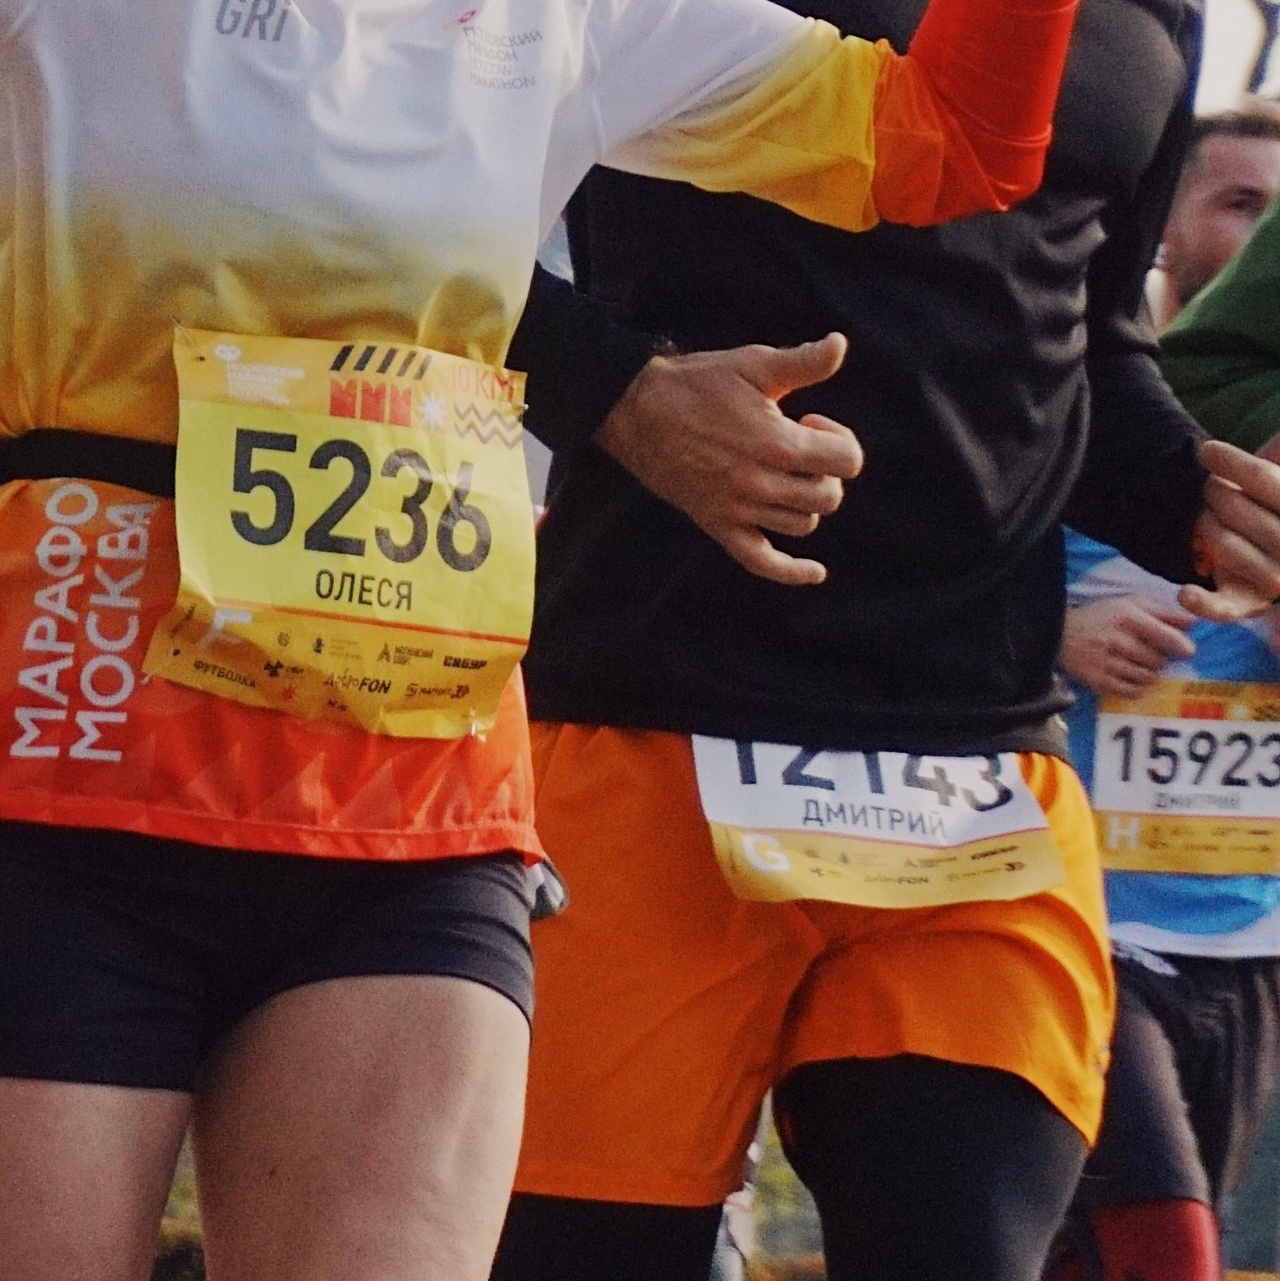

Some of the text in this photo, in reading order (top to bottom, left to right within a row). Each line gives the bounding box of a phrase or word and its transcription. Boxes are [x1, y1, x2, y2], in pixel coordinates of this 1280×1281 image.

[229, 427, 492, 573] 5236
[314, 568, 413, 612] ОЛЕСЯ
[10, 482, 99, 758] МАРАФО
[69, 501, 161, 763] МОСКВА
[193, 659, 257, 690] ФУТБОЛКА
[1111, 725, 1280, 788] 15923
[801, 798, 948, 838] ДМИТРИЙ
[740, 832, 791, 872] G
